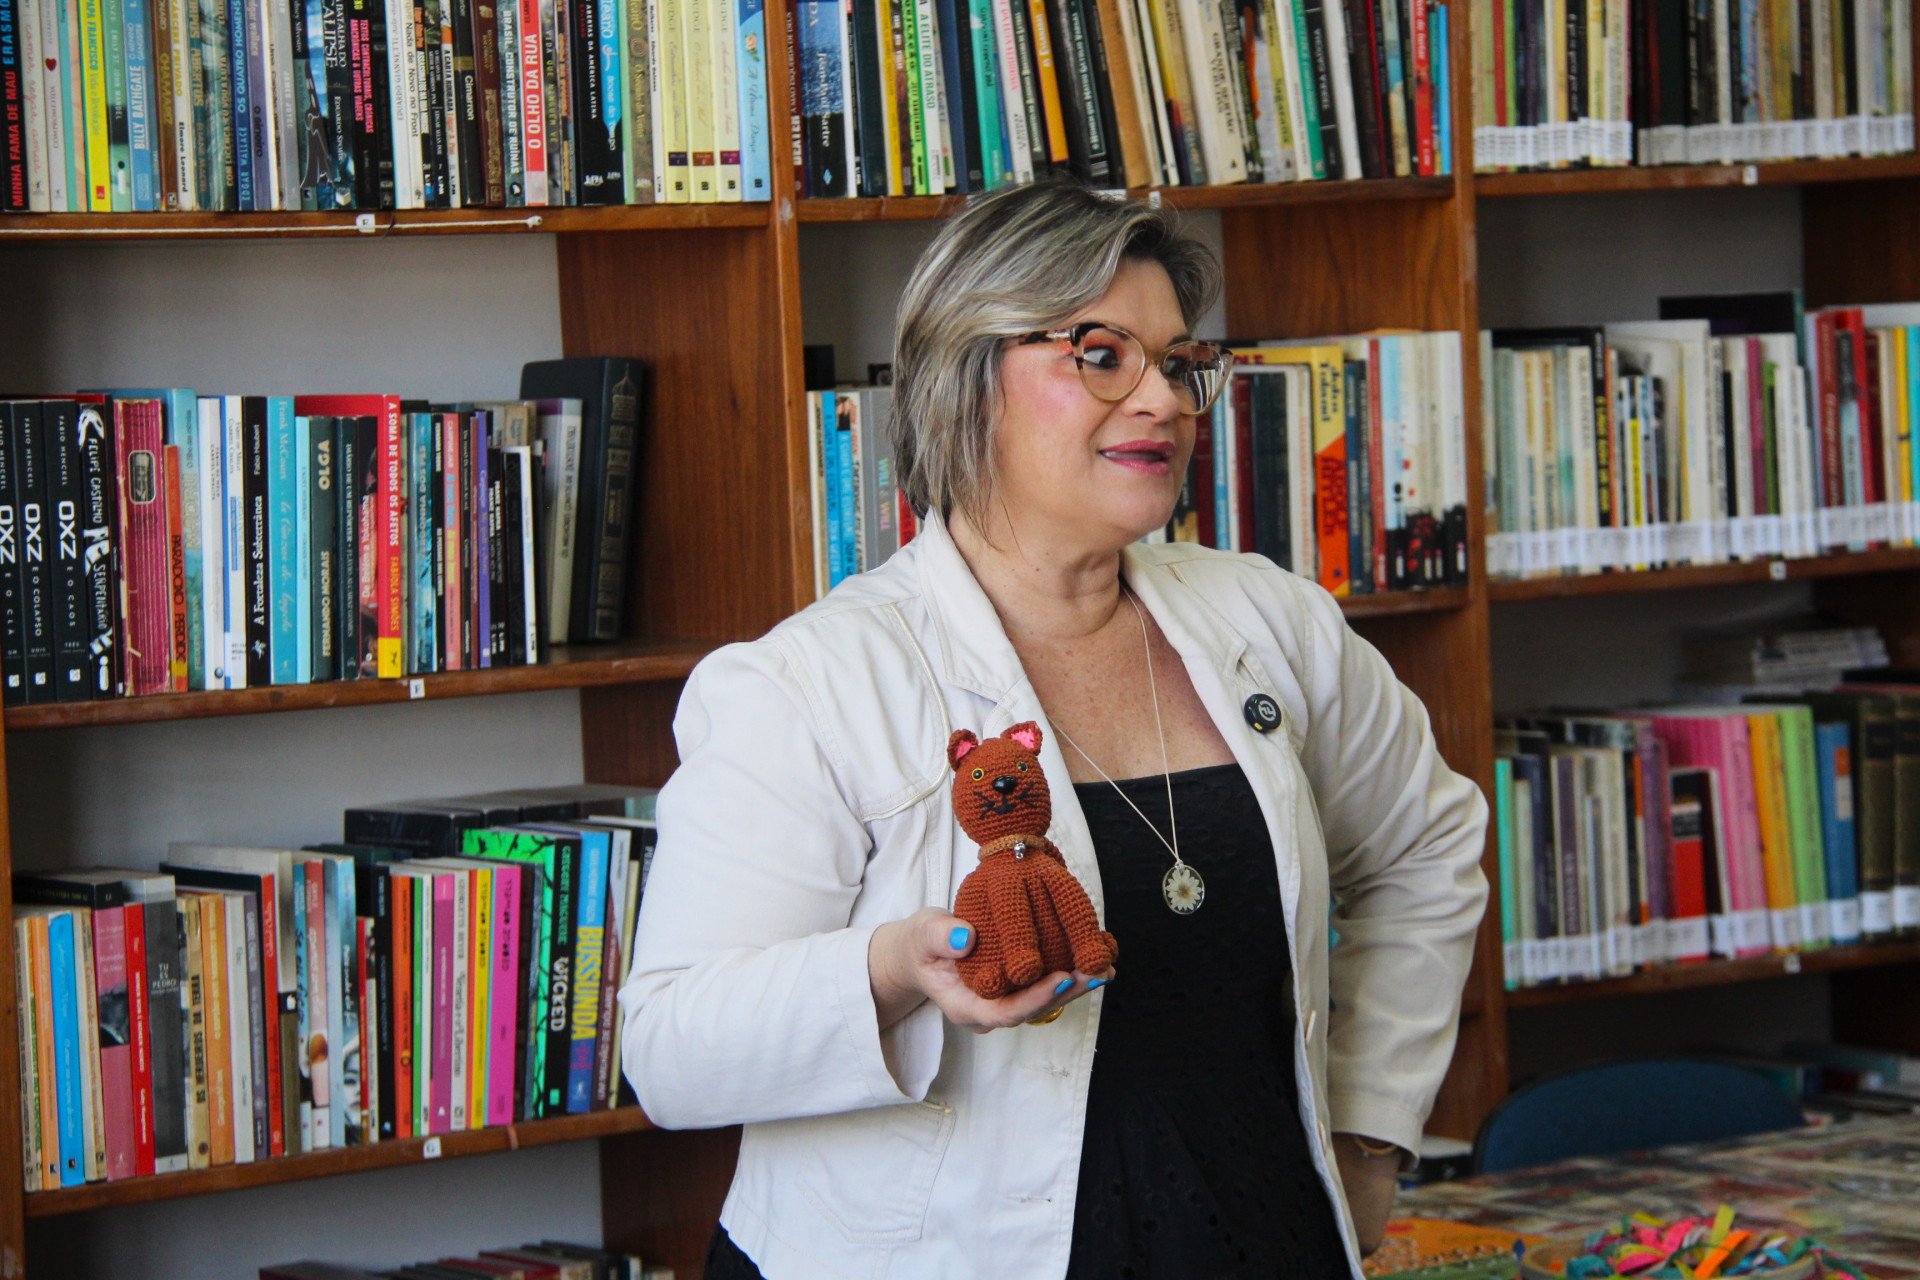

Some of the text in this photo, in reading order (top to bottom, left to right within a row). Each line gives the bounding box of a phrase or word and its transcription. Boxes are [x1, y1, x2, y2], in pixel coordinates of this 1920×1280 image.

[86, 0, 99, 71] PAPA FRANCISCO
[360, 20, 369, 41] TEXTOS
[920, 24, 931, 51] ELITE
[1072, 12, 1082, 40] VARGAS
[233, 0, 246, 113] OS QUATRO HOMENS
[587, 41, 595, 51] DA
[923, 54, 932, 68] DO
[173, 49, 183, 96] PRIVADO
[283, 71, 292, 98] JAMES
[406, 22, 419, 137] Nada de Novo no Front
[505, 52, 516, 118] CONSTRUTOR
[588, 54, 596, 88] AMÉRICA
[925, 70, 935, 109] ATRASO
[1082, 74, 1092, 100] MATOU
[0, 0, 23, 206] MINHA FAMA DE MAU ERASMO
[114, 91, 122, 120] MANDEL
[130, 65, 146, 149] BILLY BATHGATE
[464, 75, 475, 120] Cimarron
[524, 34, 541, 149] O OLHO DA RUA
[590, 91, 598, 119] LATINA
[508, 121, 517, 134] DE
[608, 105, 617, 119] do
[821, 113, 830, 147] Sartre
[1088, 115, 1099, 143] HOMEM
[180, 156, 188, 192] Leonard
[239, 127, 250, 200] EDGAR WALLACE
[509, 137, 520, 174] RUÍNAS
[24, 418, 32, 445] FABIO
[58, 416, 66, 442] FABIO
[279, 400, 289, 480] Frank McCourt
[26, 449, 34, 489] HENCKEL
[60, 446, 68, 486] HENCKEL
[253, 451, 261, 476] Fabio
[319, 440, 331, 490] OLGA
[346, 474, 352, 486] DE
[388, 402, 399, 546] A SOMA DE TODOS OS AFETOS
[879, 458, 890, 487] WILL
[346, 487, 352, 499] UM
[24, 503, 42, 563] OXZ
[58, 500, 77, 560] OXZ
[361, 495, 370, 543] Yokohama
[880, 501, 891, 530] WILL
[0, 505, 15, 565] OXZ
[171, 535, 185, 606] PARADOXO
[253, 495, 264, 625] A Fortaleza Subterrânea
[362, 551, 371, 583] Belém
[829, 544, 840, 573] GREEN
[6, 590, 12, 598] O
[33, 576, 39, 584] O
[362, 584, 370, 598] De
[390, 556, 401, 631] FABÍOLA SIMÕES
[33, 589, 42, 637] COLAPSO
[68, 595, 76, 628] CAOS
[321, 551, 331, 657] FERNANDO MORAIS
[550, 956, 570, 1033] WICKED
[571, 925, 605, 1041] BUSSUNDA
[190, 974, 206, 1104] OS HERDEIROS DA TERRA
